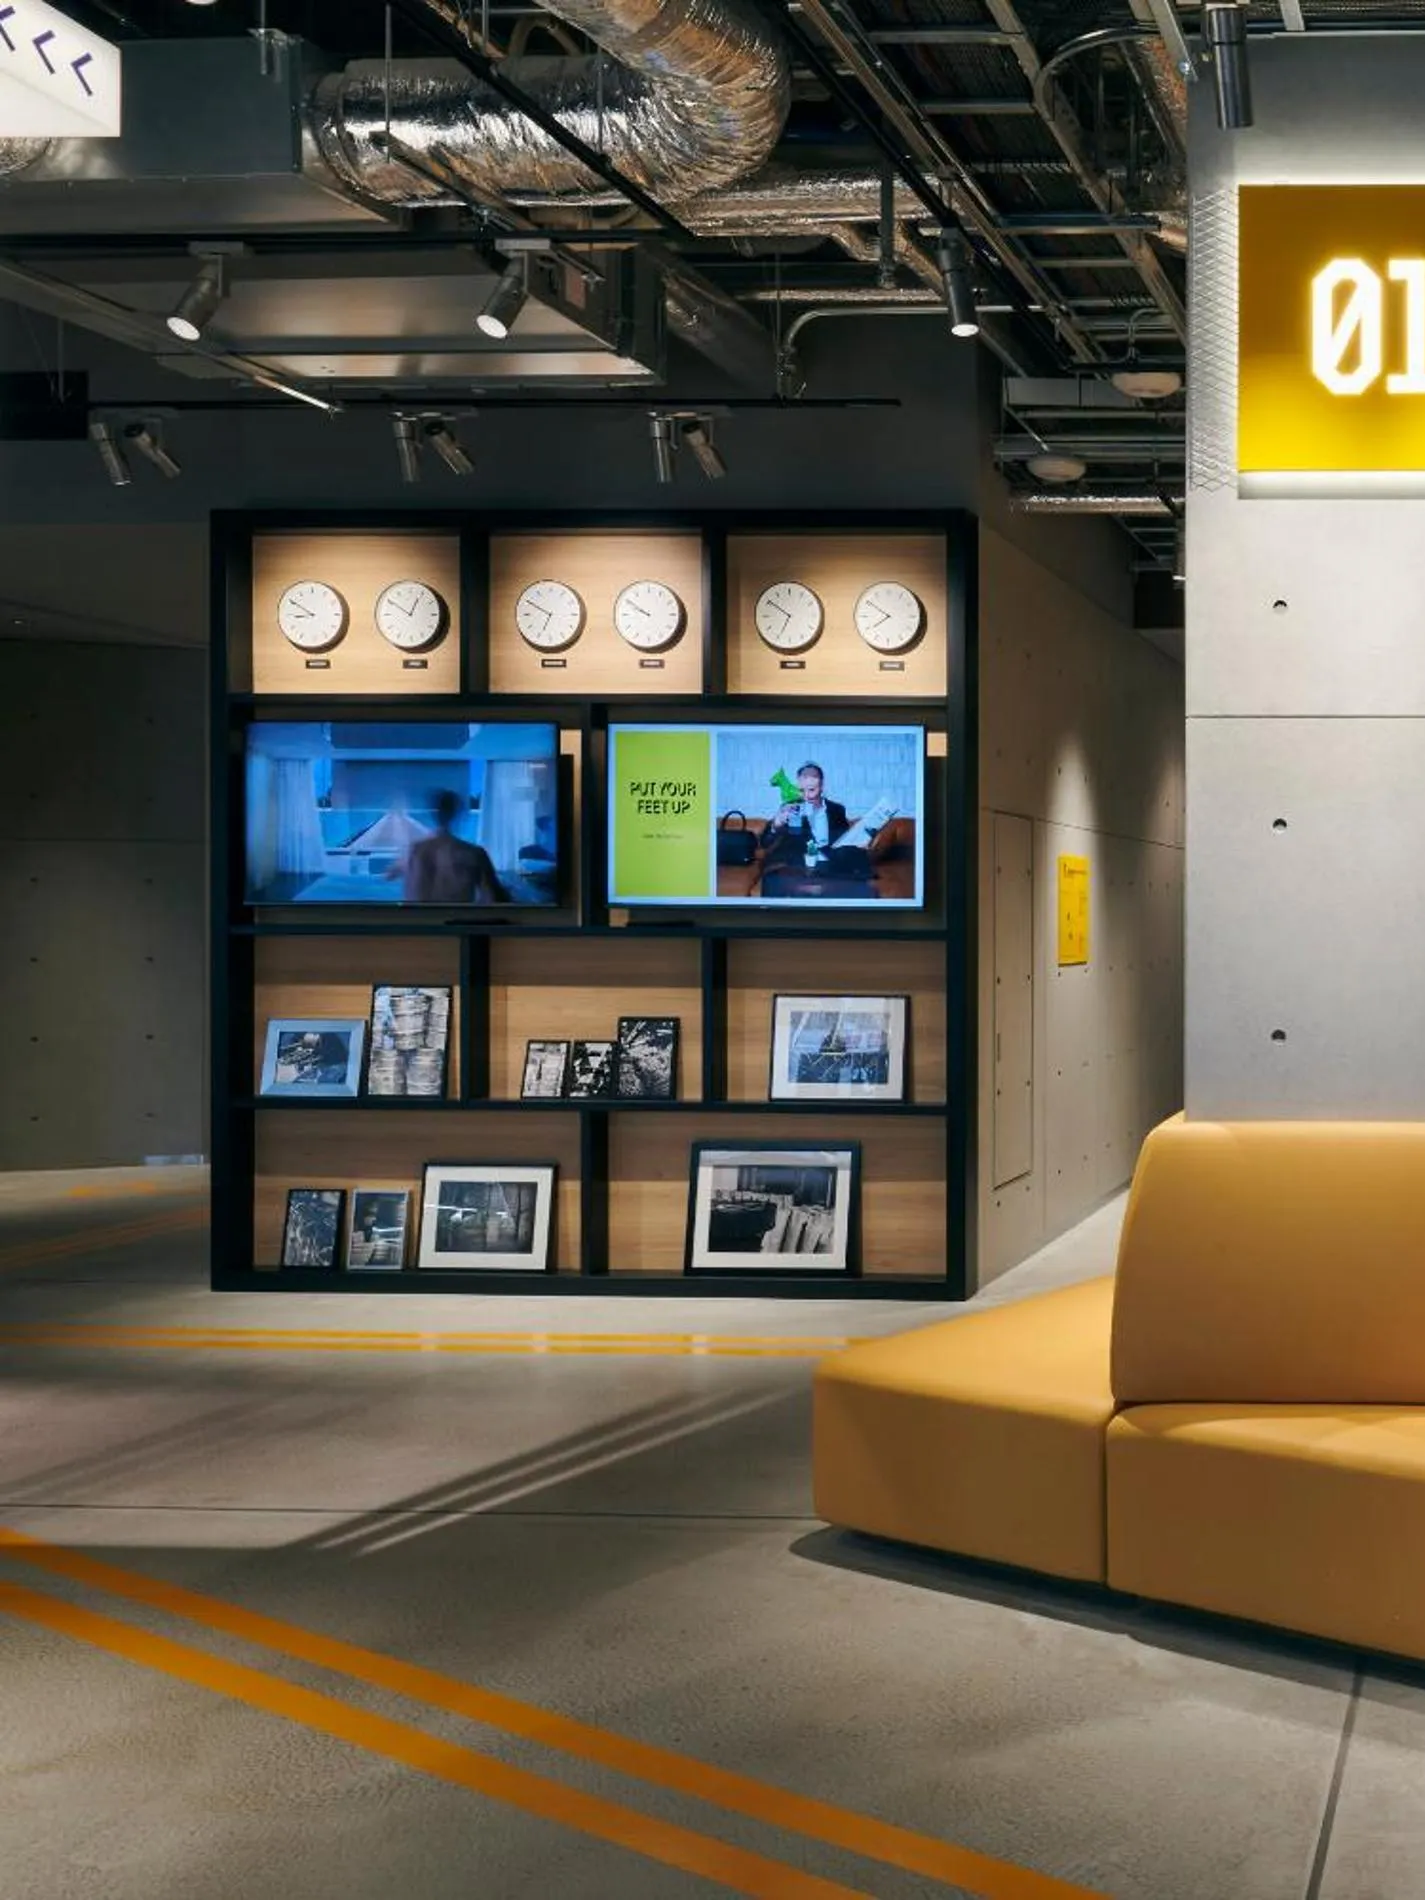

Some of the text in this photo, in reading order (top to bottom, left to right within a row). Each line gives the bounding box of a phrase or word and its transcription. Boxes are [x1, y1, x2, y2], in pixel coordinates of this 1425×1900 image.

[630, 782, 696, 796] PUT YOUR
[638, 800, 690, 814] FEET UP
